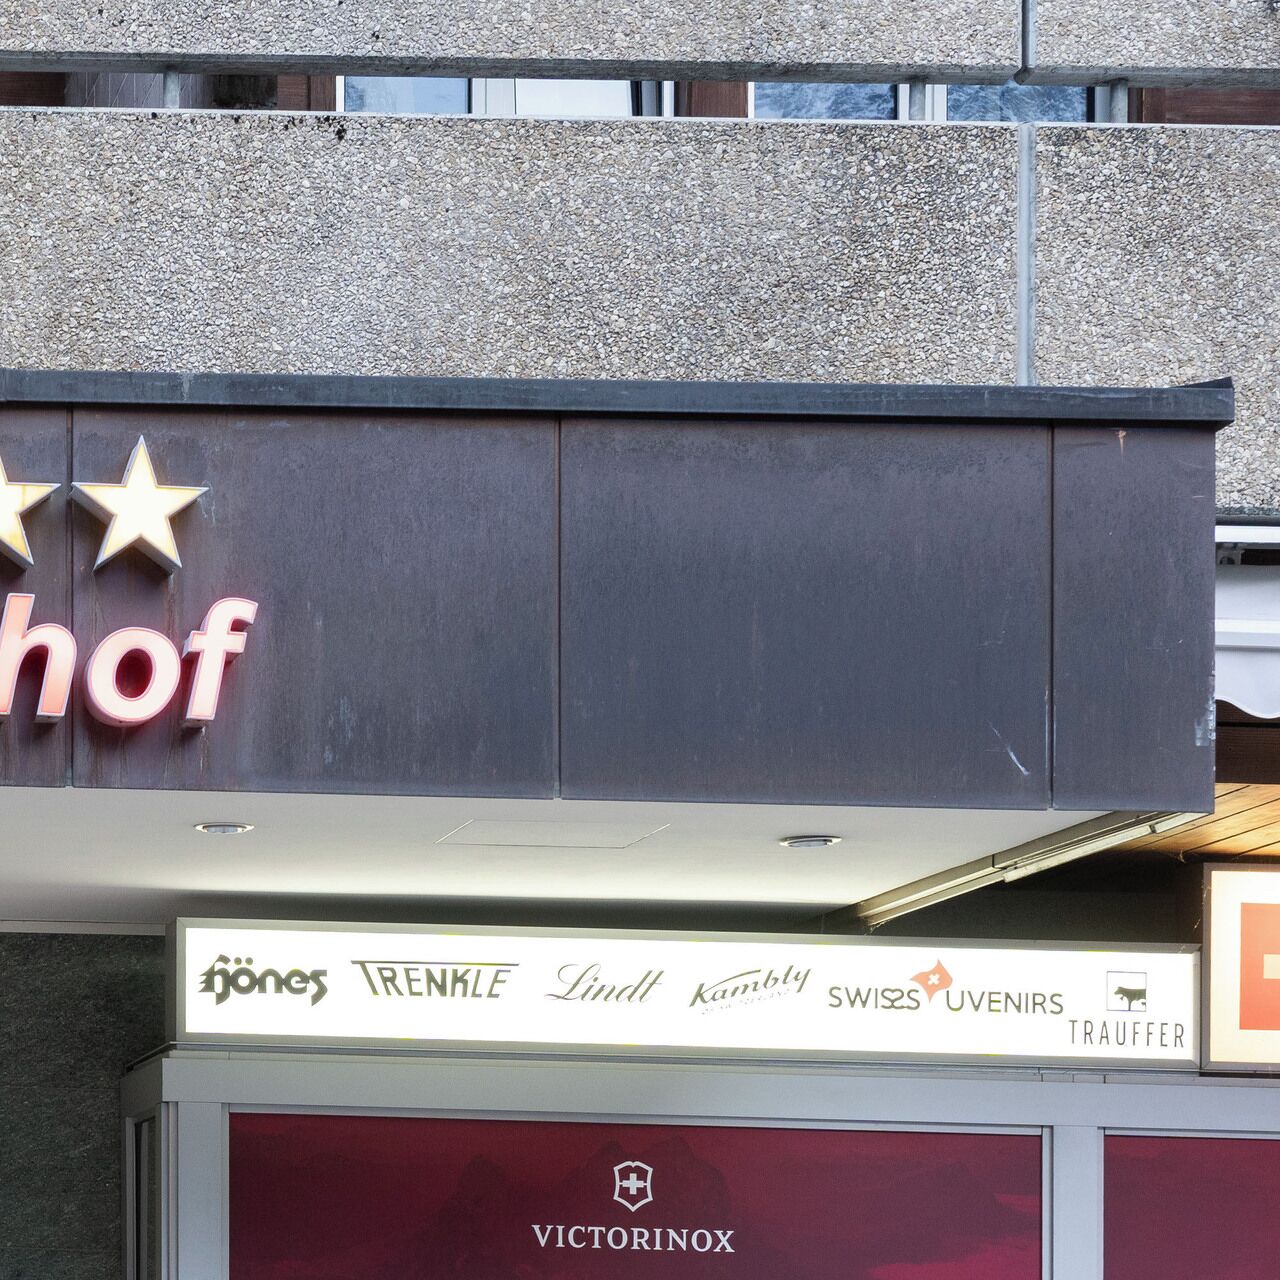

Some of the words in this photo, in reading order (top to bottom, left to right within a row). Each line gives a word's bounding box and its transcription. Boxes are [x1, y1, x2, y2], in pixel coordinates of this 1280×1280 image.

[351, 960, 519, 999] TRENKLE
[544, 963, 664, 1004] Lindt
[689, 965, 811, 1007] Kambly
[1069, 1020, 1185, 1049] TRAUFFER
[531, 1225, 735, 1252] VICTORINOX
